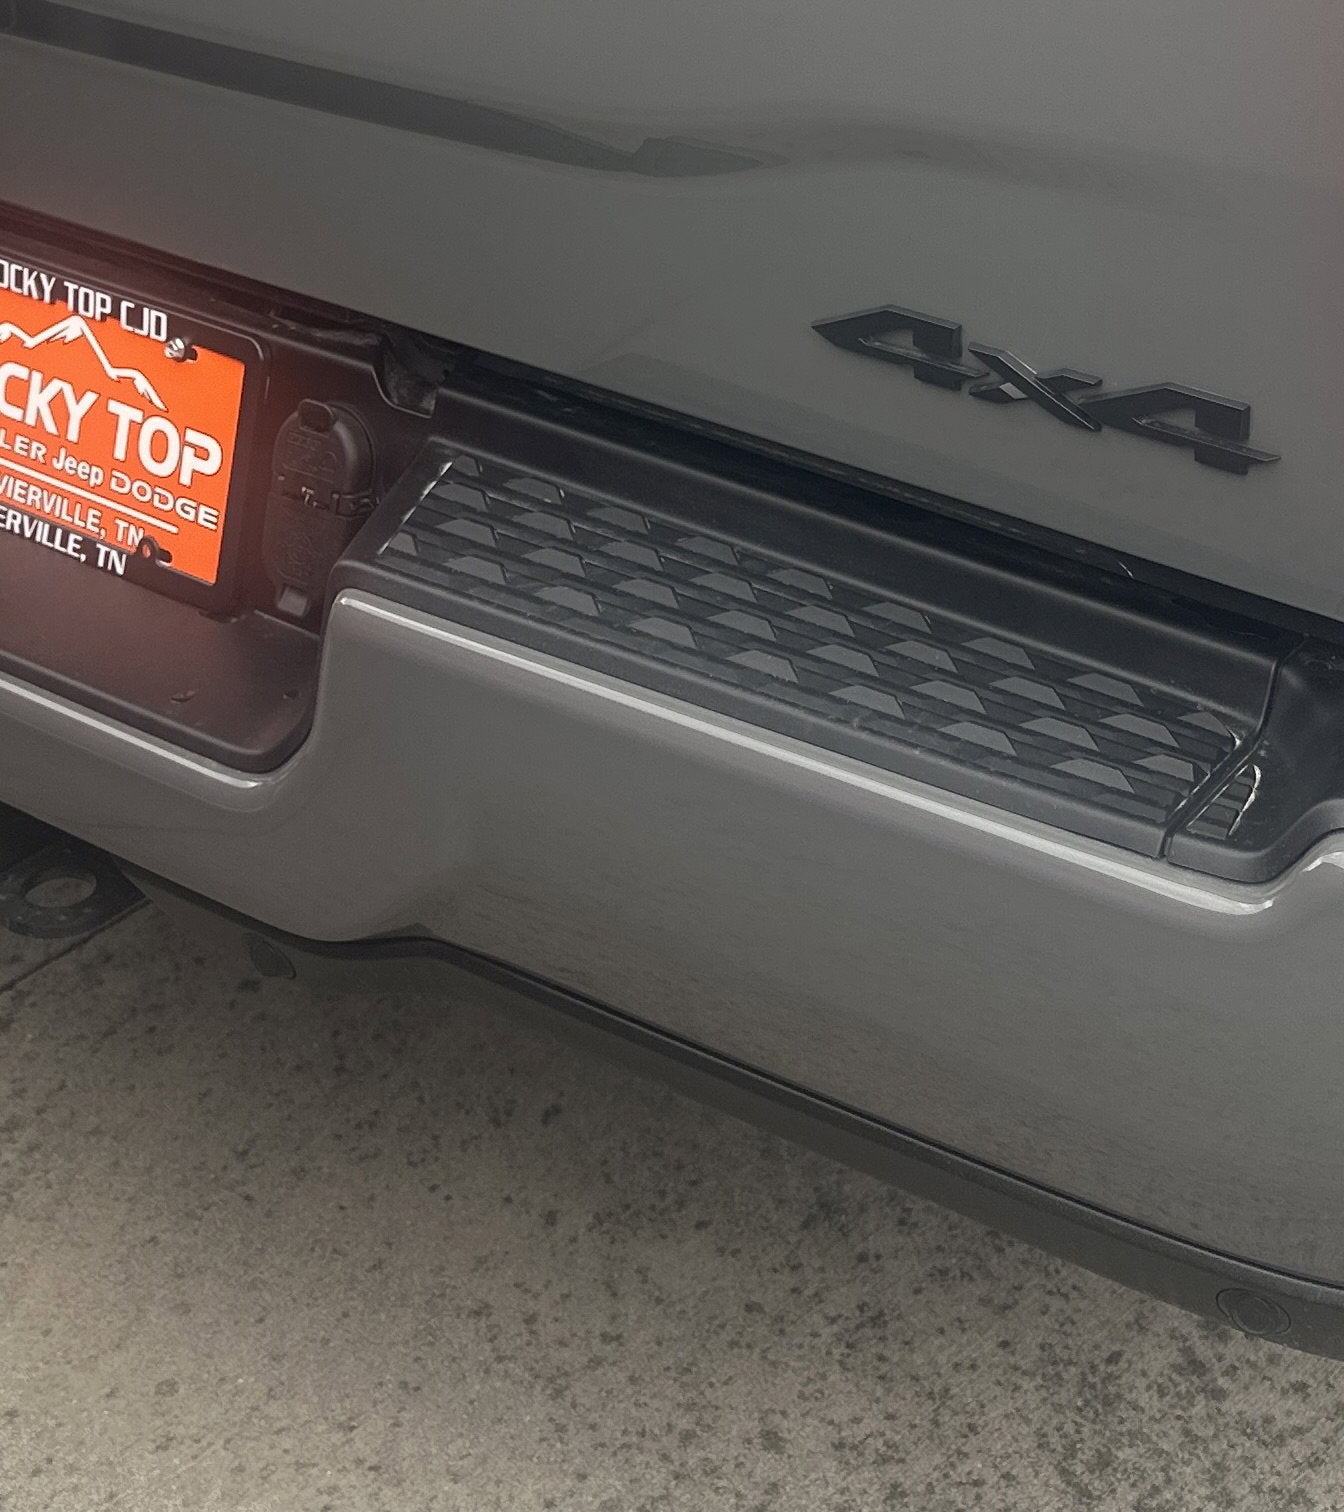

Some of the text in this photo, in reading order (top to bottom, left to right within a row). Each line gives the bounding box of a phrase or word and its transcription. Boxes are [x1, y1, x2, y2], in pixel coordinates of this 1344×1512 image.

[63, 281, 112, 321] TOP
[120, 301, 168, 343] CJD
[106, 399, 223, 487] TOP
[51, 446, 104, 489] Jeep
[109, 471, 219, 531] DODGE
[95, 545, 127, 577] TN
[115, 519, 145, 548] TN
